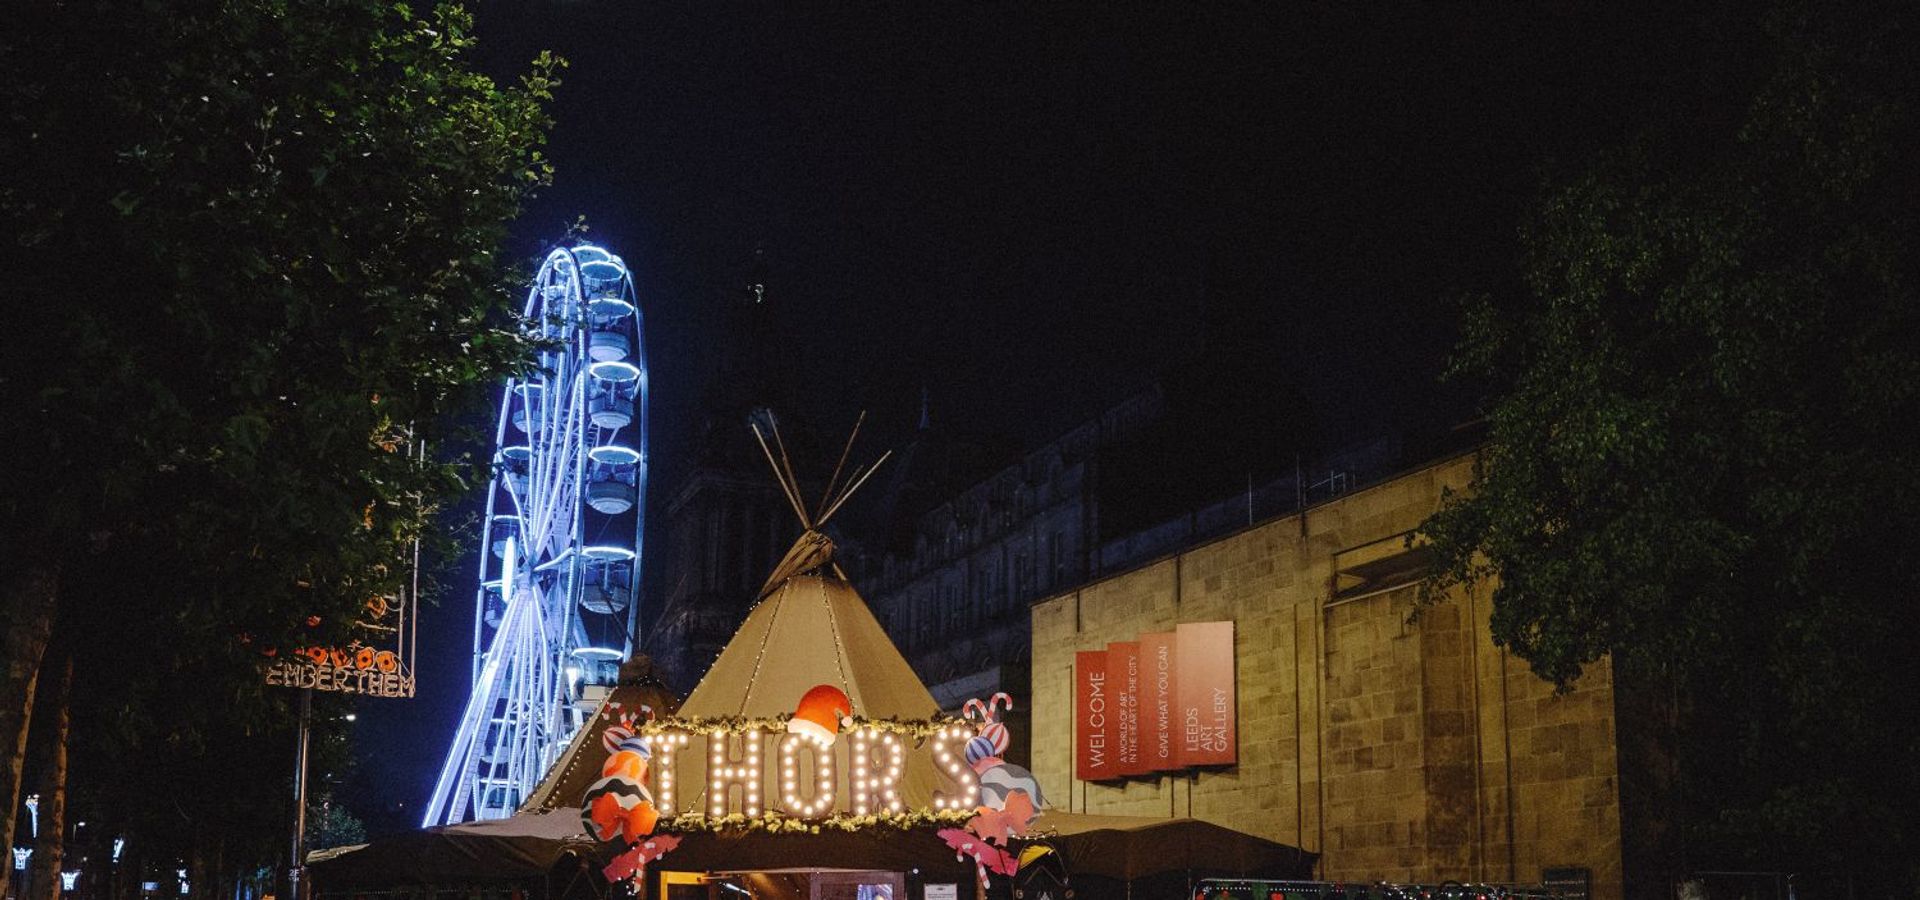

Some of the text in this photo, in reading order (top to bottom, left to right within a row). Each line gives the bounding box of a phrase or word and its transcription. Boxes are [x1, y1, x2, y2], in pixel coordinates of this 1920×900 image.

[262, 661, 416, 698] EMBER THEM
[1129, 694, 1136, 708] OF
[1158, 646, 1169, 758] GIVE WHAT YOU CAN
[1089, 671, 1105, 768] WELCOME
[1120, 691, 1128, 763] A WORLD OF ART
[1186, 707, 1198, 752] LEEDS
[1200, 724, 1212, 752] ART
[1214, 688, 1227, 752] GALLERY
[645, 728, 981, 818] THORS
[1129, 753, 1136, 763] IN
